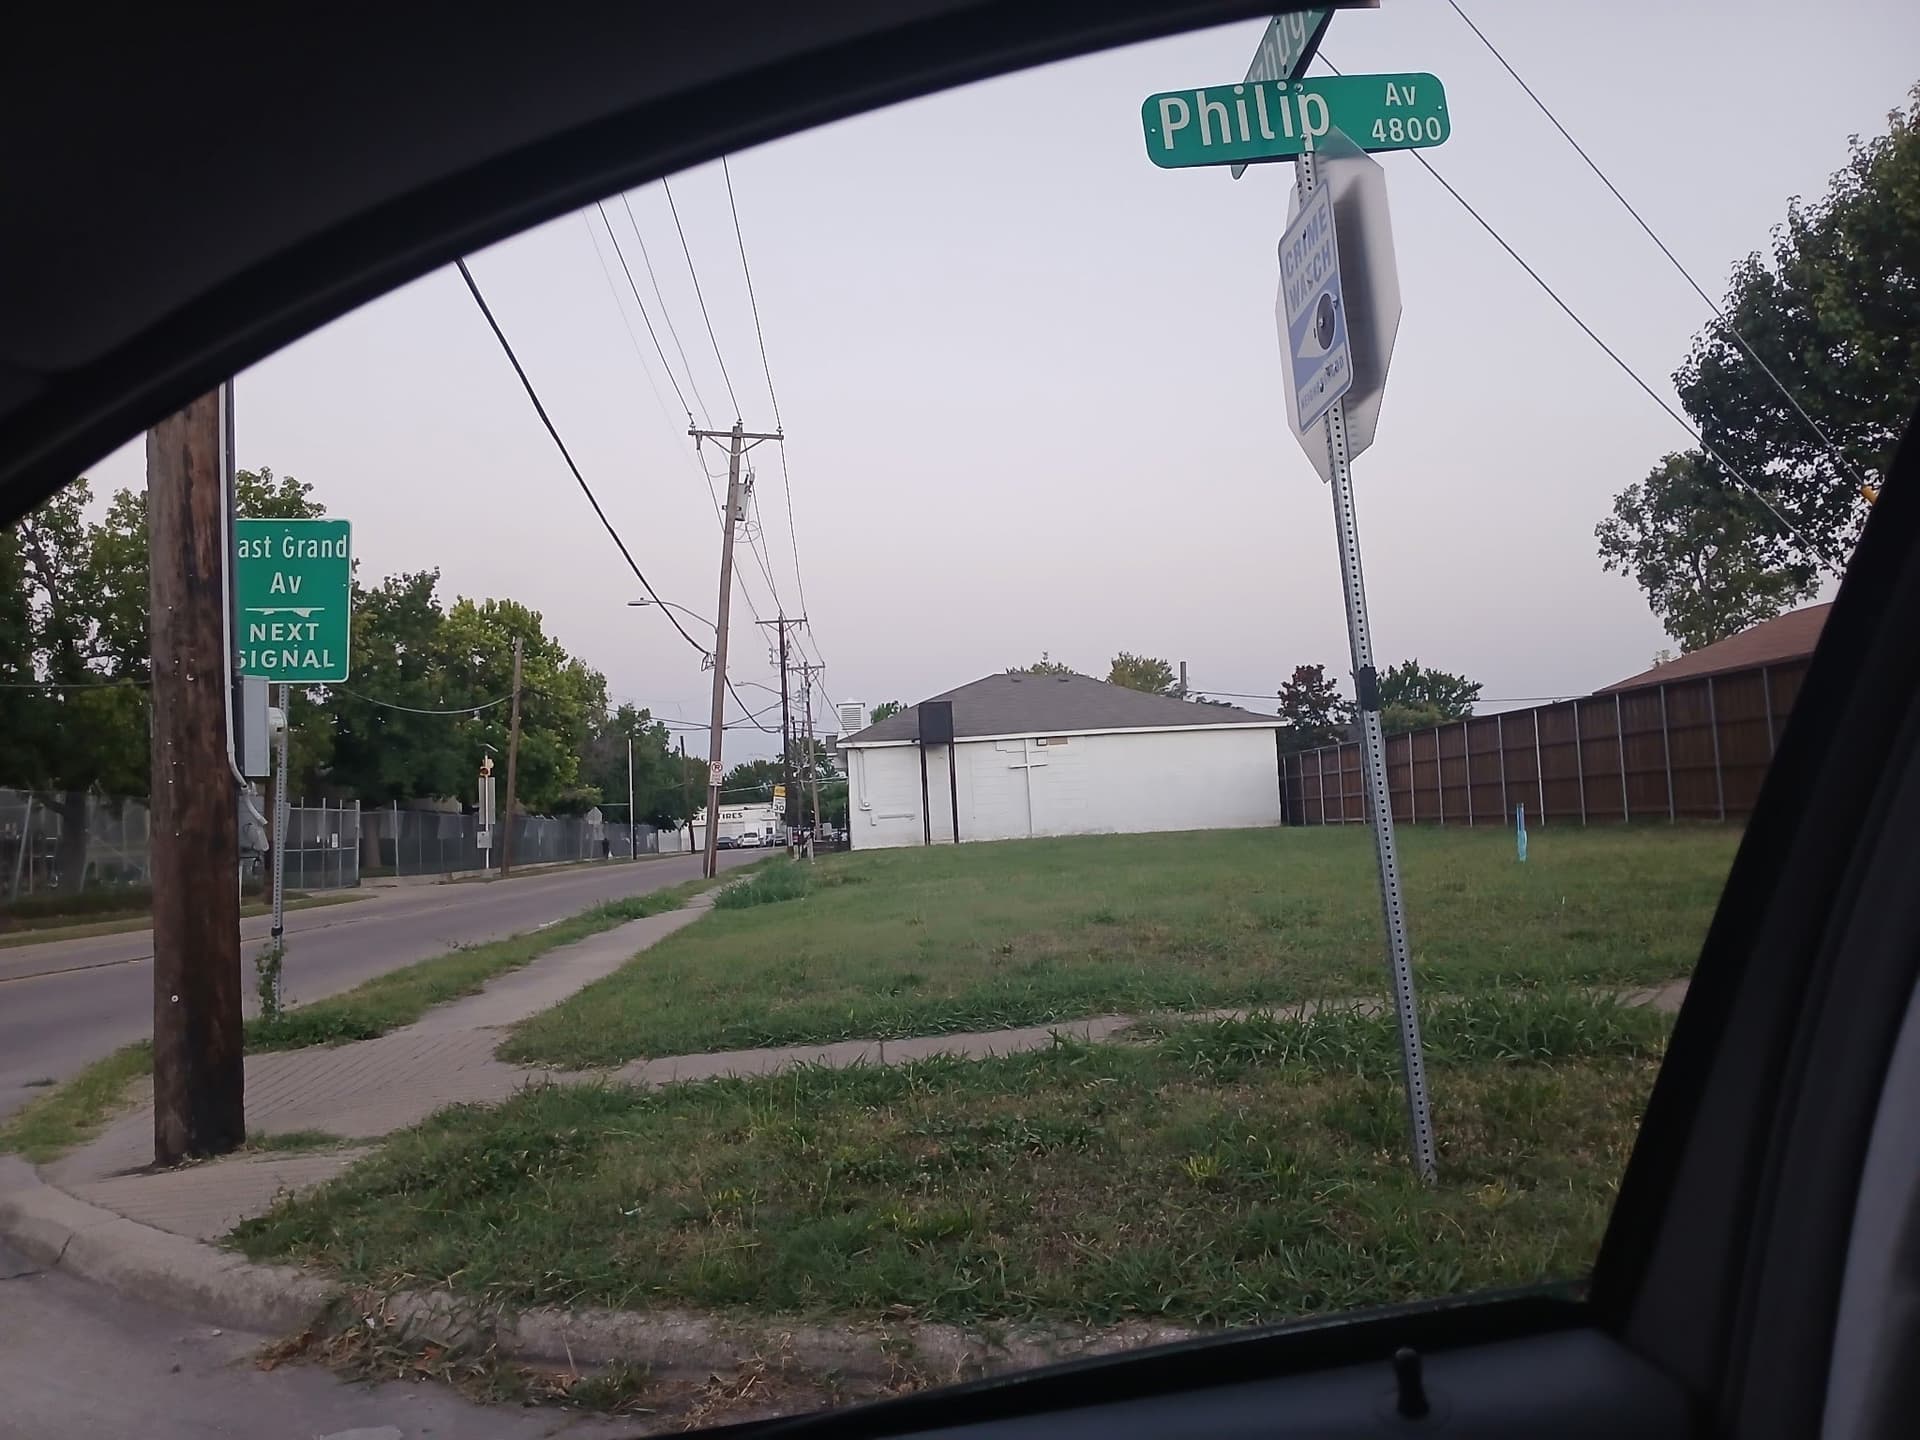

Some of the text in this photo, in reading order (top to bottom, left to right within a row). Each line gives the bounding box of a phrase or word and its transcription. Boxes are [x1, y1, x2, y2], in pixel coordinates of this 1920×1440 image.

[1385, 82, 1416, 107] Av
[1158, 80, 1330, 152] Philip
[1371, 116, 1442, 143] 4800
[1285, 202, 1328, 278] CRIME
[238, 534, 347, 559] ast Grand
[270, 571, 302, 595] Av
[250, 623, 320, 643] NEXT
